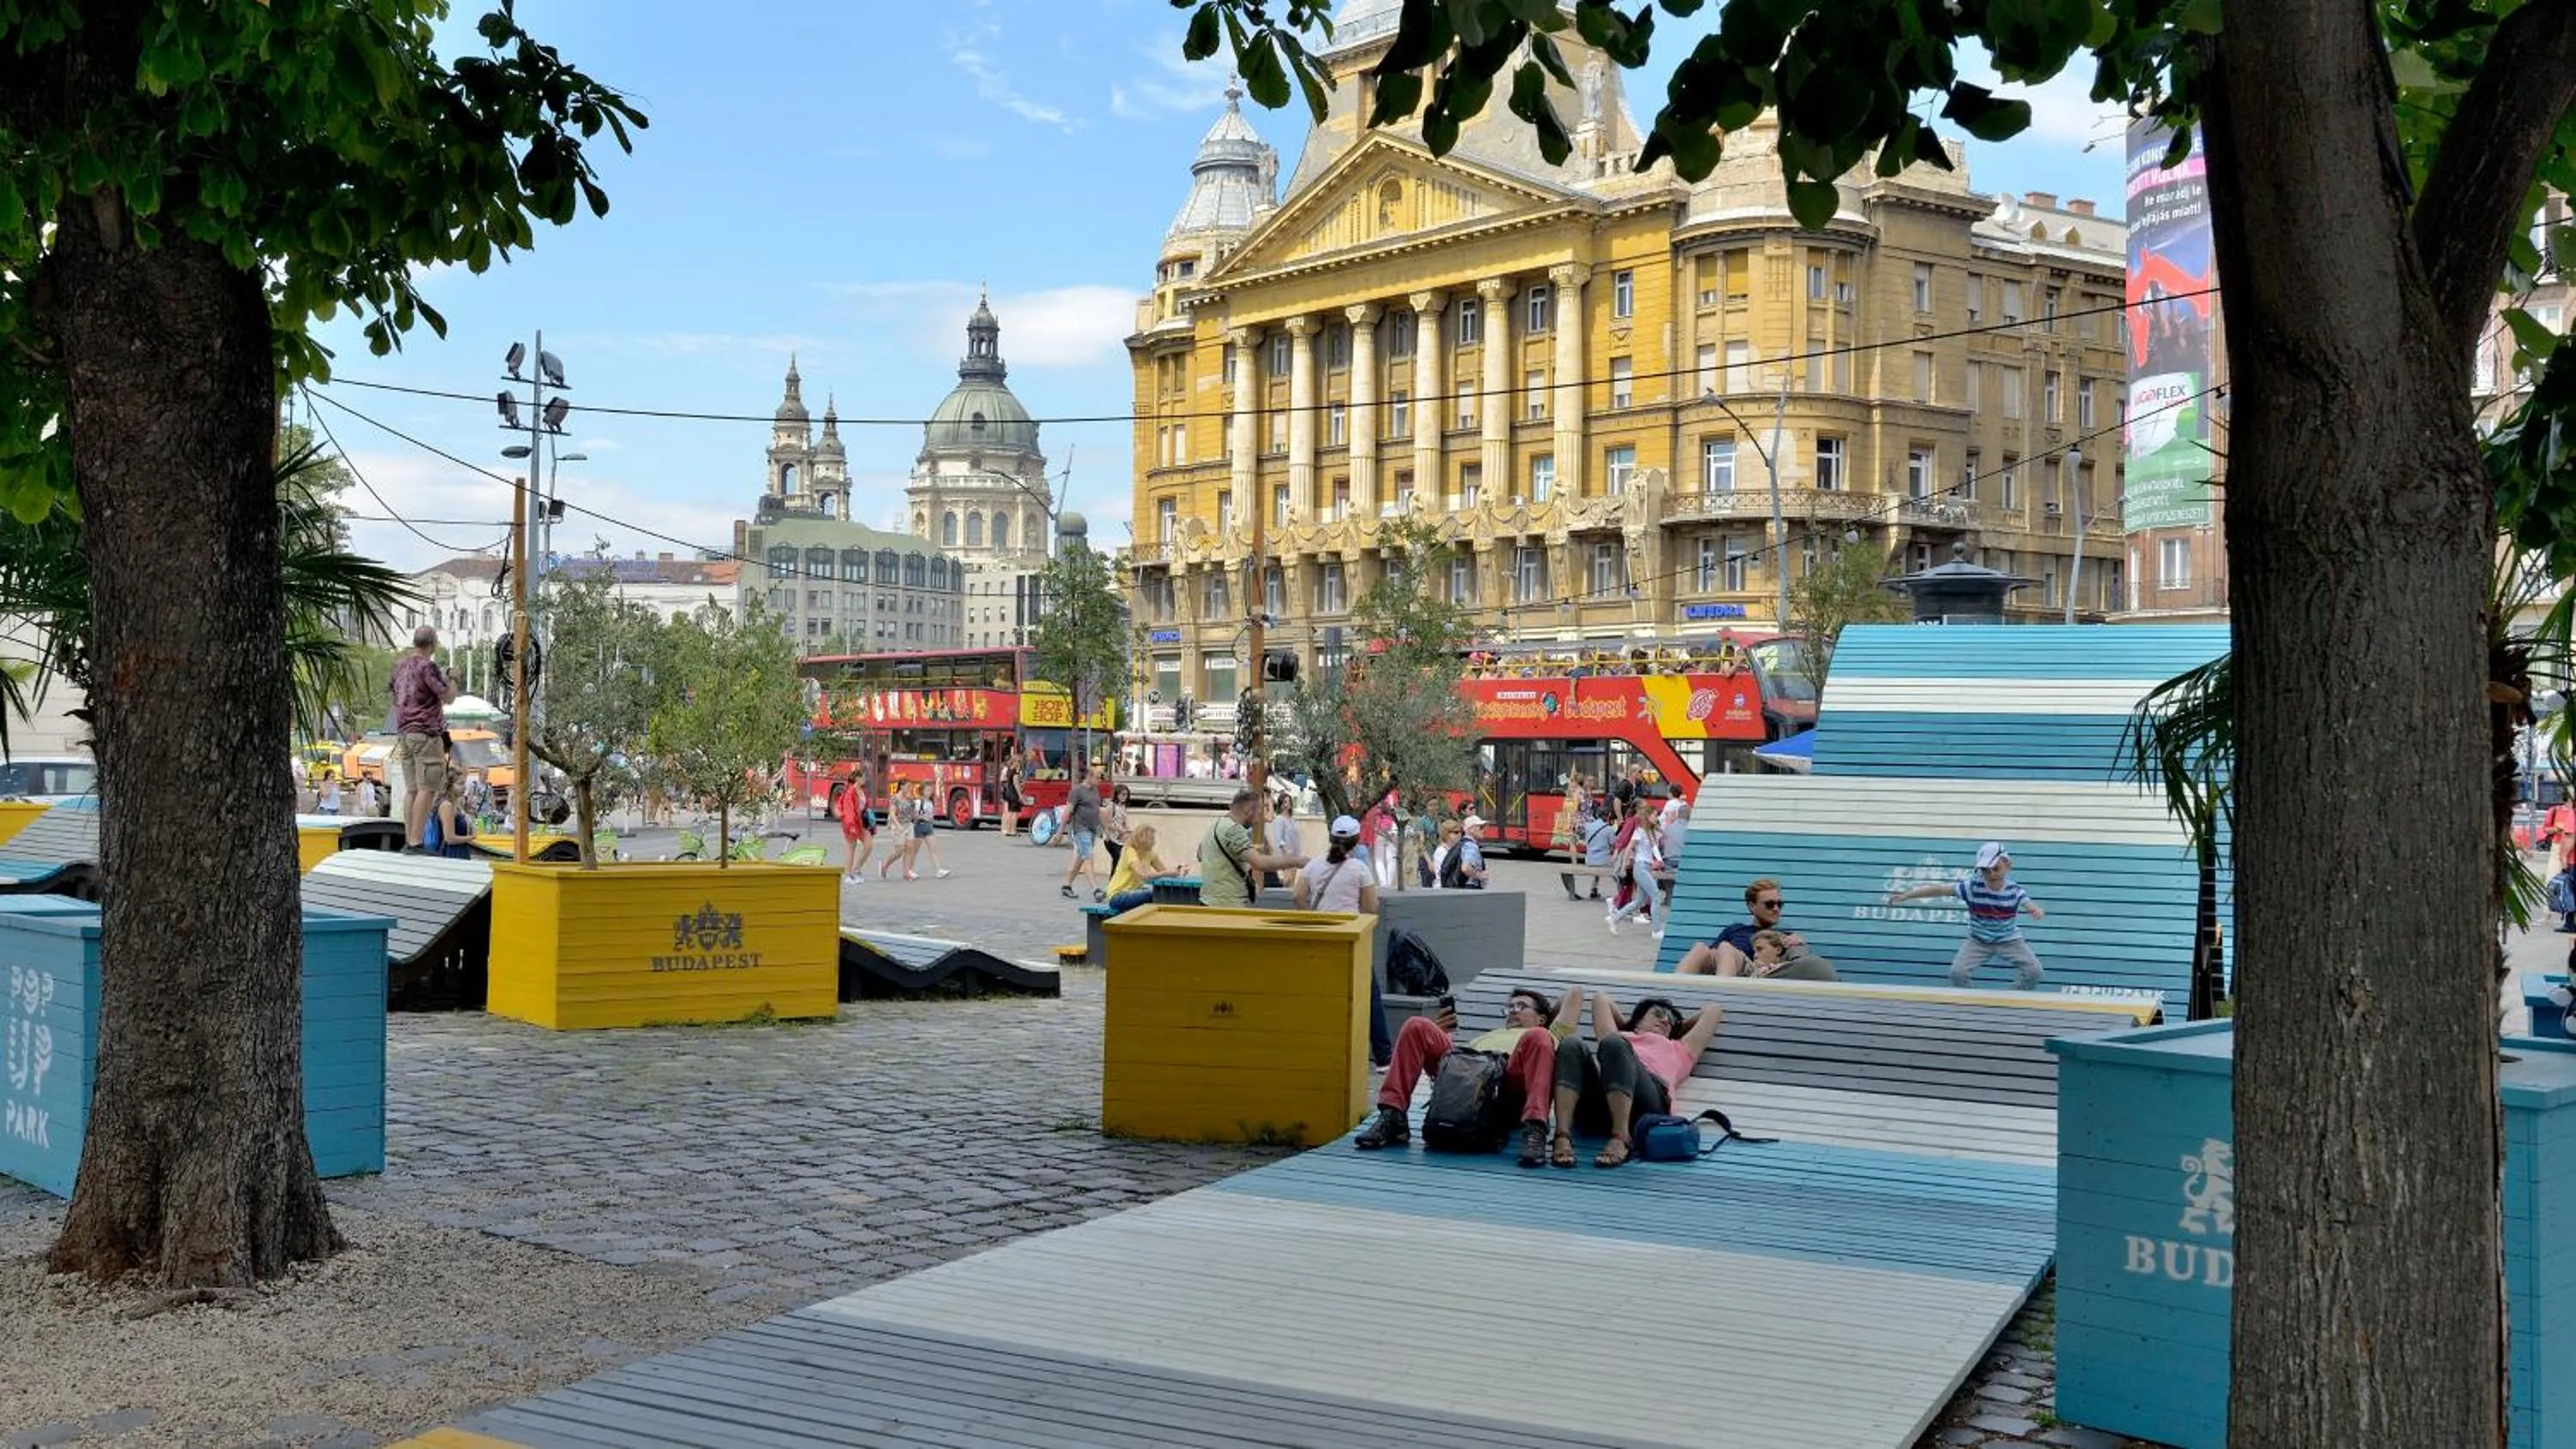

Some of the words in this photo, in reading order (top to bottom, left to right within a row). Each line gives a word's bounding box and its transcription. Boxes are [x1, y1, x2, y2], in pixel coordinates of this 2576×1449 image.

[1854, 906, 1971, 925] BUDAPES
[649, 952, 762, 972] BUDAPEST
[6, 1098, 49, 1149] PARK
